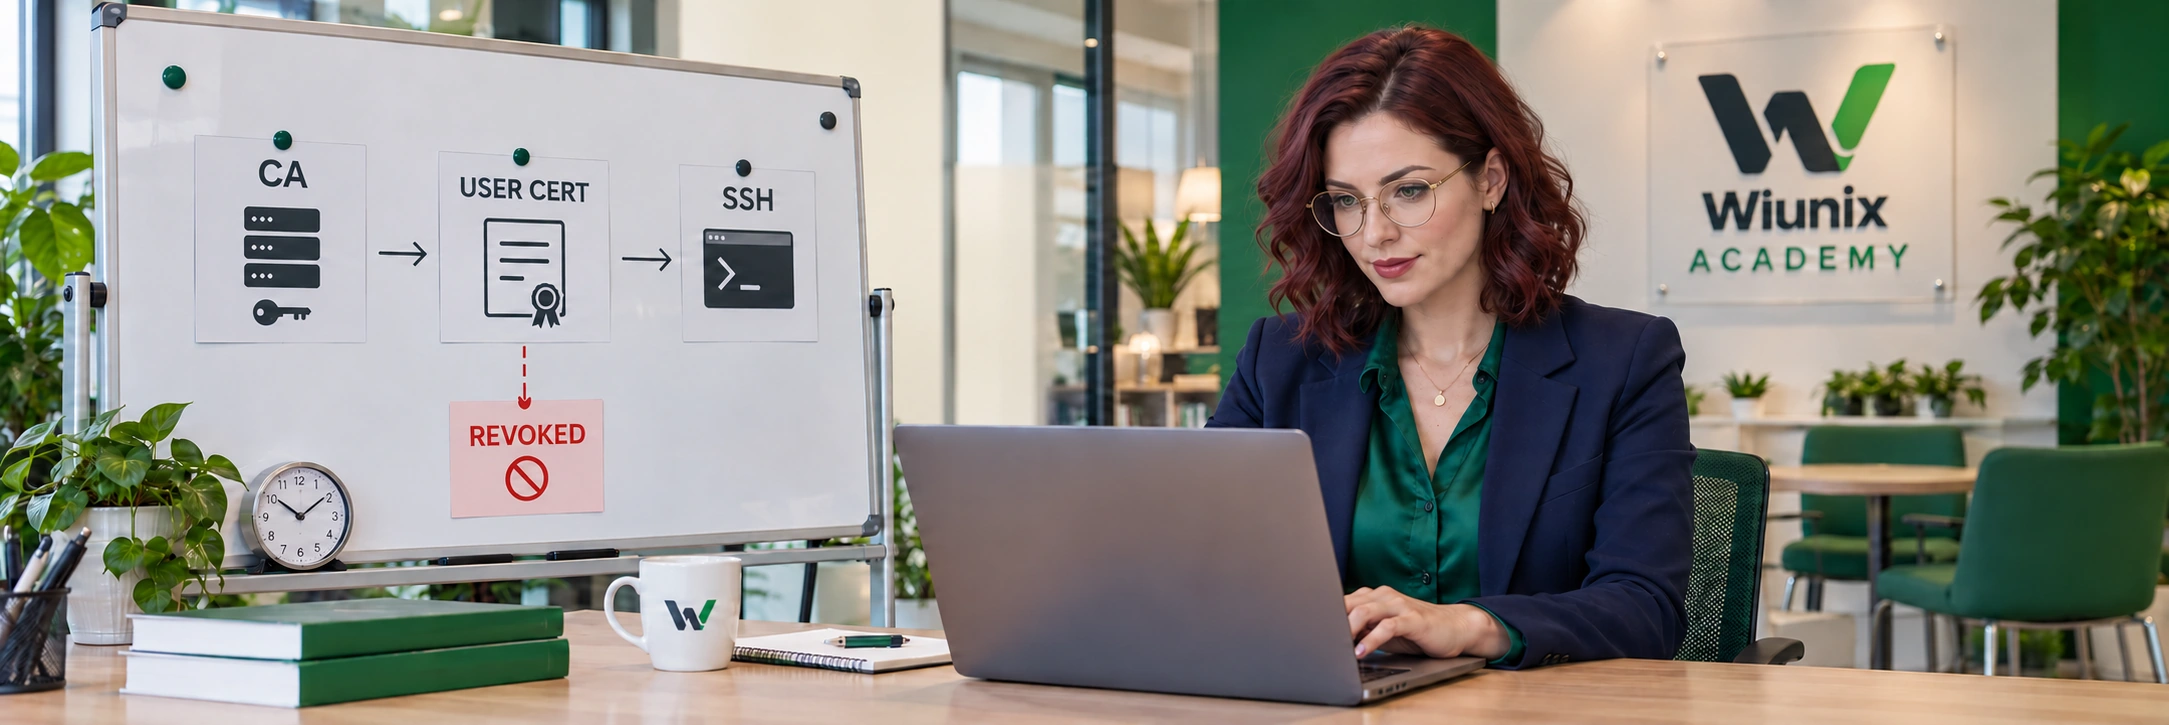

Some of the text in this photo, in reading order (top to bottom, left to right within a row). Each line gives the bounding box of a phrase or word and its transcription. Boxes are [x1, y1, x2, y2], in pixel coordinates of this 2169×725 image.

[259, 159, 307, 189] CA
[461, 177, 589, 203] USER CERT
[723, 187, 773, 212] SSH
[1702, 185, 1887, 231] Wiunix
[1690, 244, 1907, 273] ACADEMY
[470, 424, 586, 447] REVOKED
[278, 480, 287, 490] 11
[294, 476, 305, 486] 12
[266, 494, 278, 504] 10
[326, 492, 332, 503] 2
[262, 512, 269, 522] 9
[332, 511, 339, 521] 3
[268, 531, 275, 541] 8
[326, 529, 333, 539] 4
[280, 544, 287, 554] 7
[297, 547, 304, 557] 6
[314, 543, 320, 552] 5
